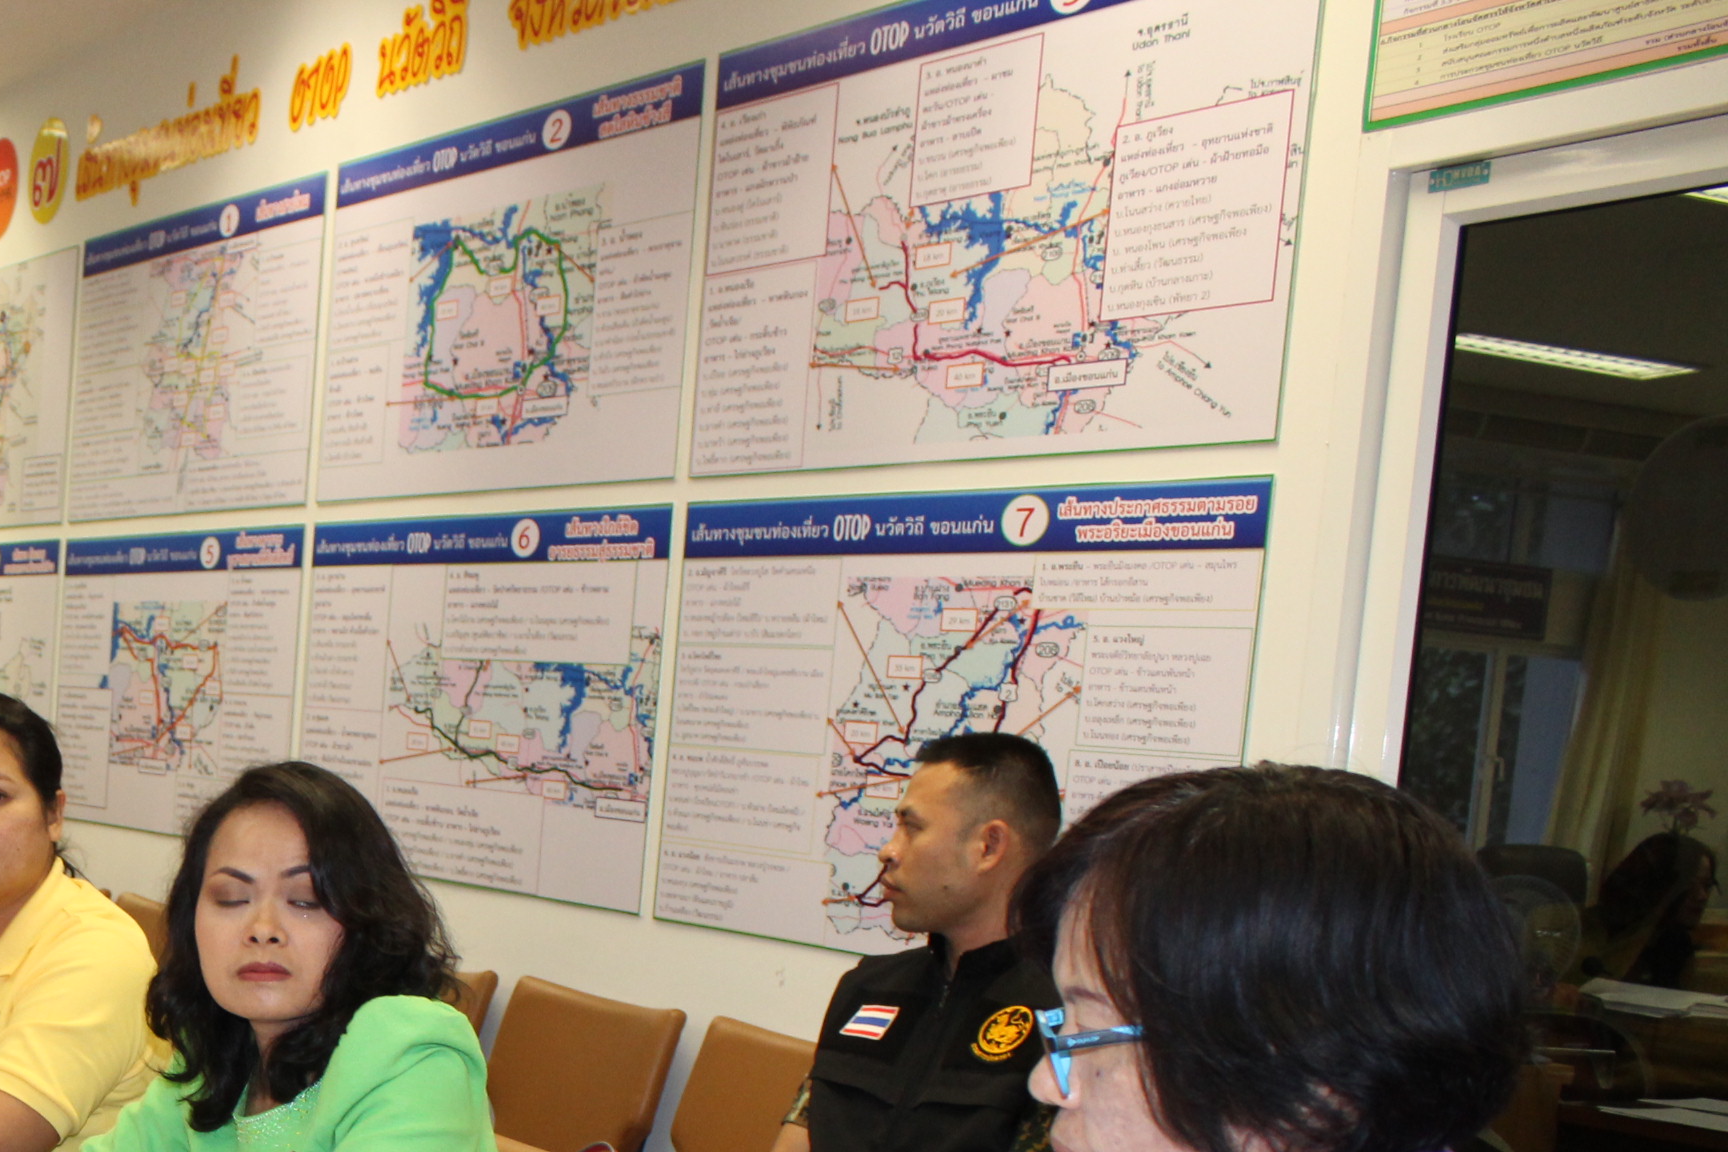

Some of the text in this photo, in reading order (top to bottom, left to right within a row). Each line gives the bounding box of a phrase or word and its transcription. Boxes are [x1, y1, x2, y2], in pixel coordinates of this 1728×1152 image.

[723, 38, 866, 93] เส้นทางชุมชนท่องเที่ยว
[870, 20, 911, 56] OTOP
[914, 7, 966, 40] นวัตวิถี
[289, 41, 352, 132] OTOP
[432, 146, 458, 173] OTOP
[549, 118, 564, 144] 2
[1121, 142, 1184, 163] แหล่งท่องเที่ยว
[1054, 368, 1119, 385] อ.เมืองขอนแก่น
[406, 532, 432, 554] OTOP
[518, 524, 531, 550] 6
[691, 496, 1258, 545] เส้นทางชุมชนท่องเที่ยว OTOP นวัตวิถี ขอนแก่น 7 เส้นทางประกาศธรรมตามรอย
[1076, 518, 1235, 542] พระอริยะเมืองขอนแก่น
